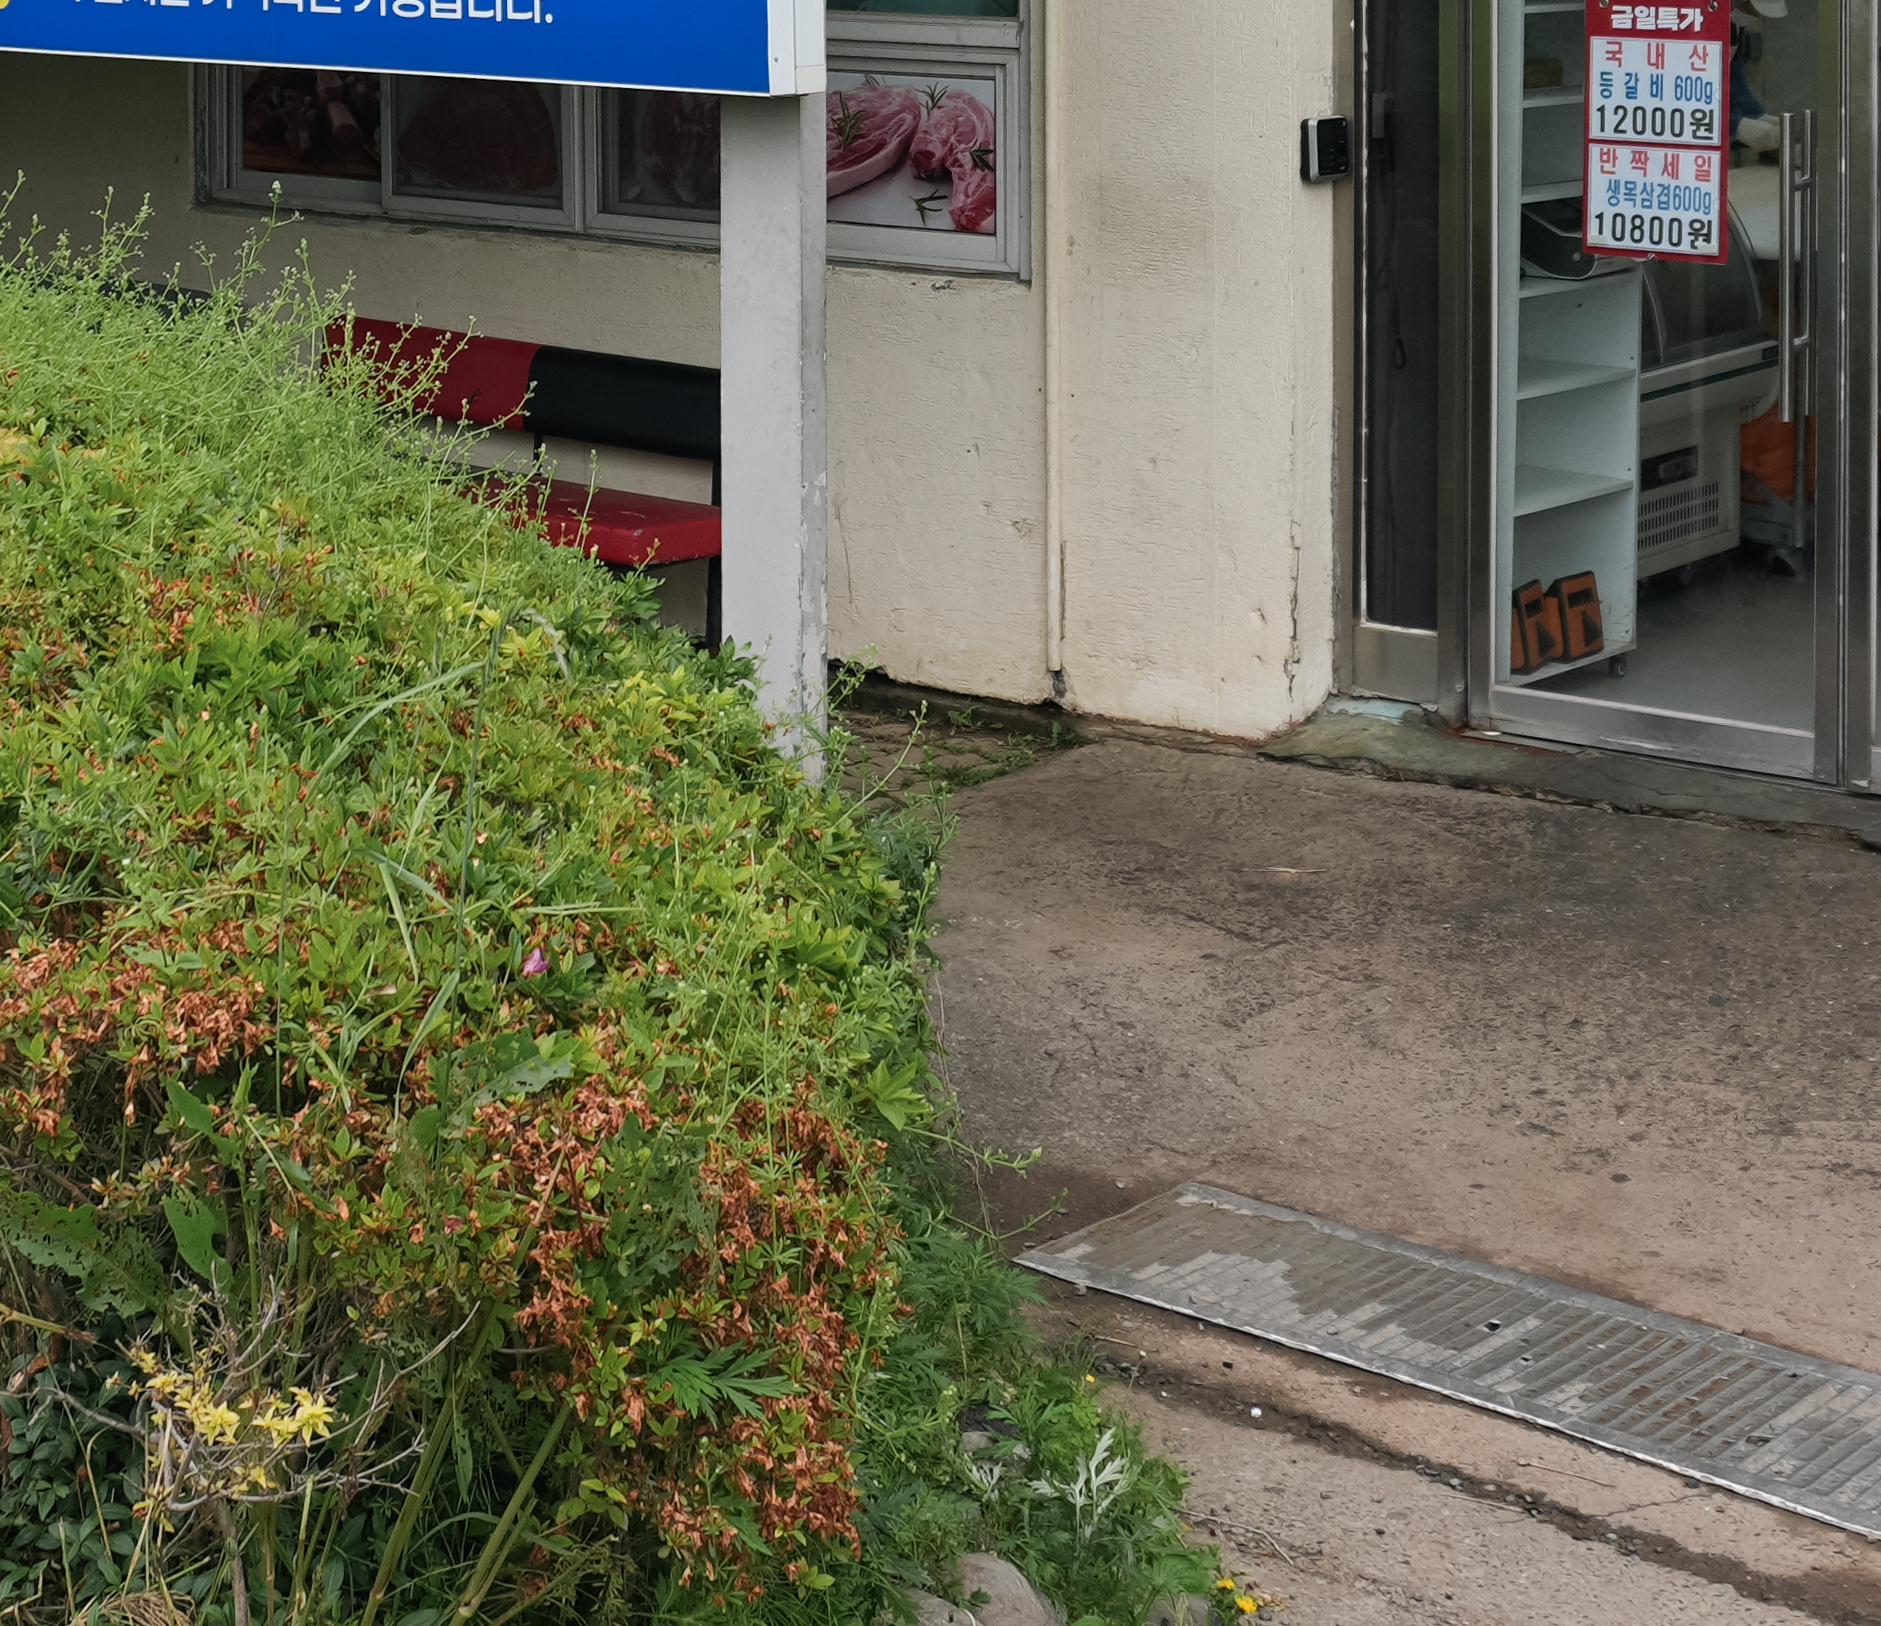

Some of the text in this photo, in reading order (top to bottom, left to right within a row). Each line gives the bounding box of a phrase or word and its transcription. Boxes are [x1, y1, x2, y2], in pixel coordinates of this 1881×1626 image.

[1611, 5, 1704, 32] 금일특가
[1674, 75, 1713, 105] 600g
[1596, 104, 1714, 141] 12000원
[1595, 211, 1713, 250] 10800원
